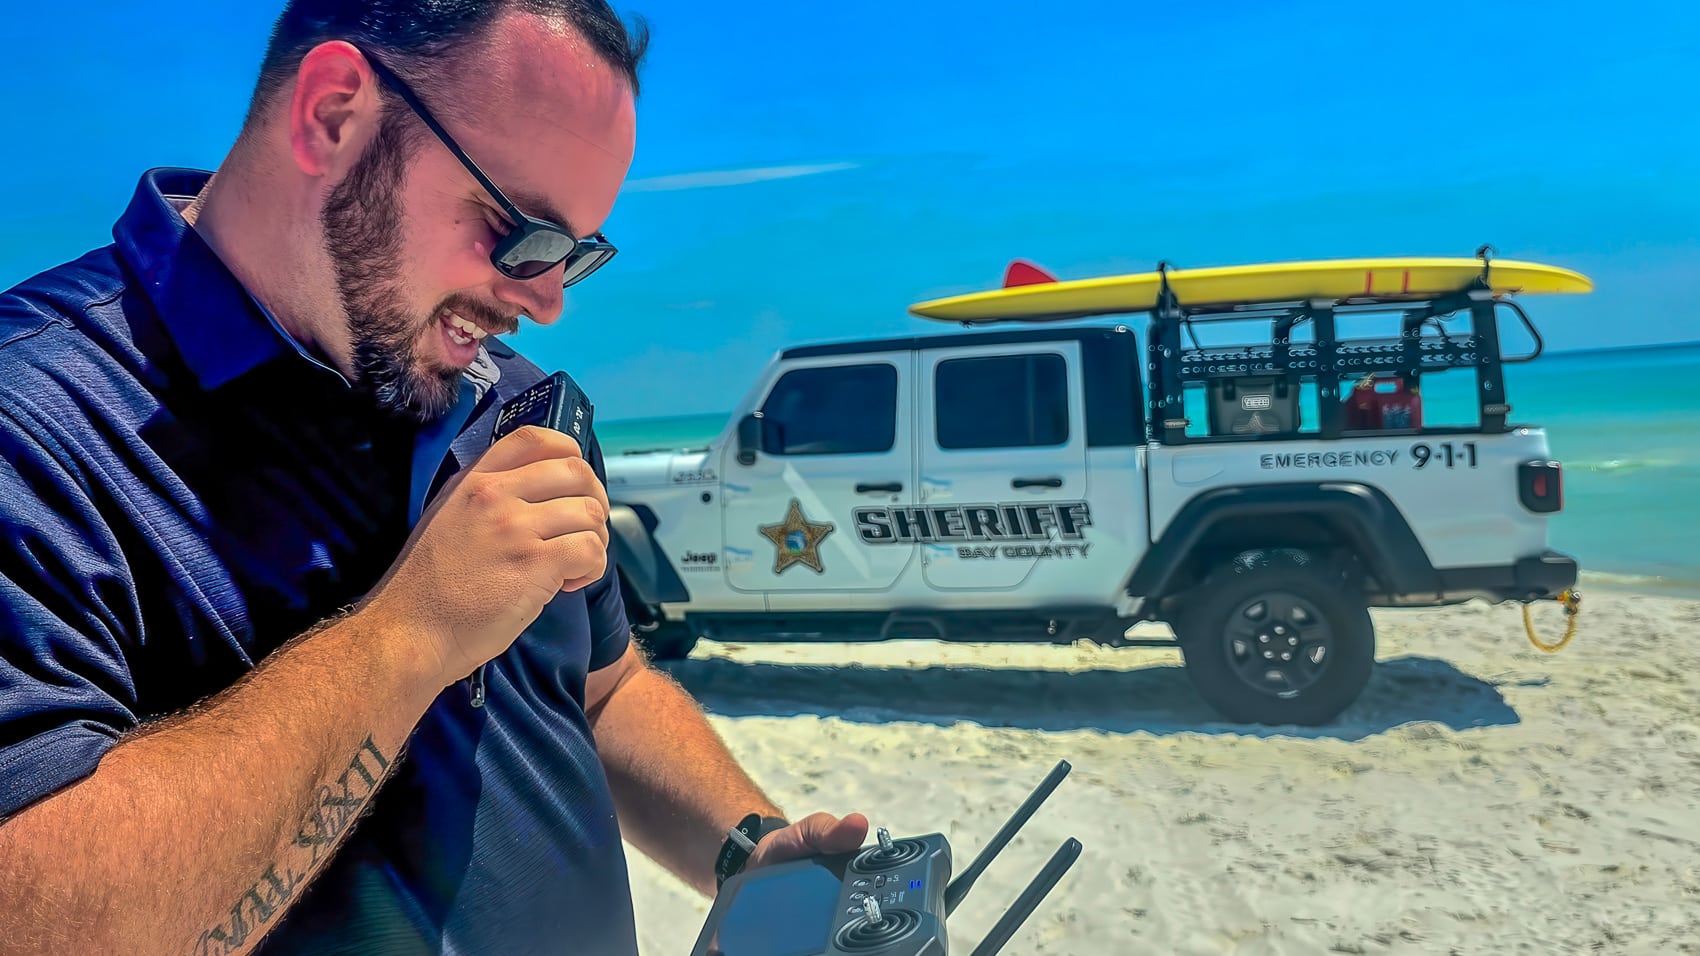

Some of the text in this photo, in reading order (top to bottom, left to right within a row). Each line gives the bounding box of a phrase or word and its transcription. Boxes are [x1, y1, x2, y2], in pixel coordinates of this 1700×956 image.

[1260, 449, 1399, 469] EMERGENCY
[853, 500, 1092, 543] SHERIFF
[681, 551, 717, 564] Jeep
[958, 544, 1091, 559] BAY COUNTY
